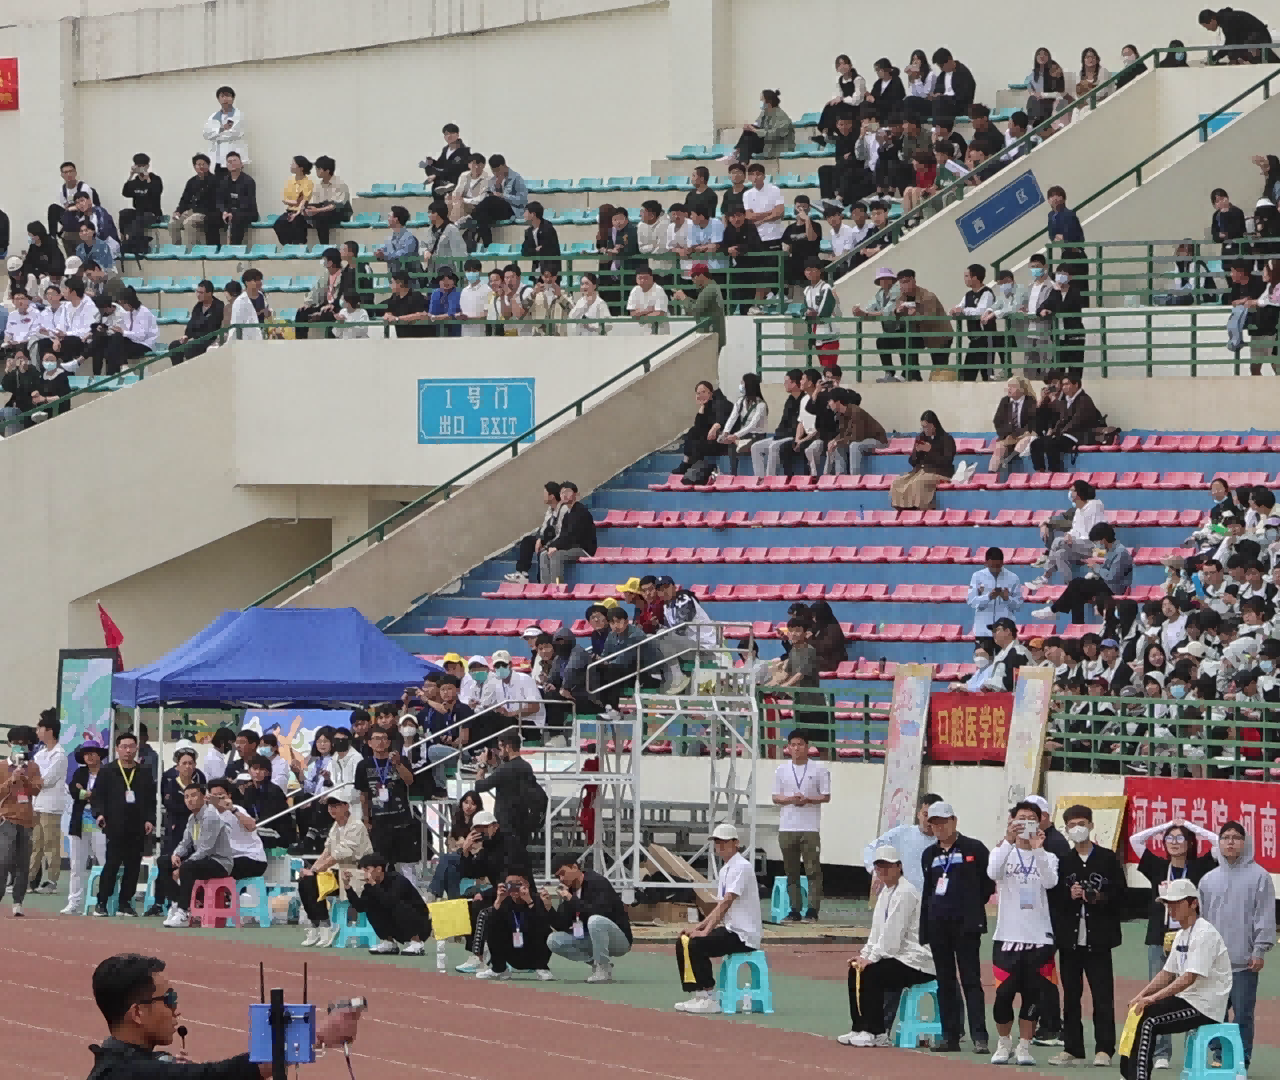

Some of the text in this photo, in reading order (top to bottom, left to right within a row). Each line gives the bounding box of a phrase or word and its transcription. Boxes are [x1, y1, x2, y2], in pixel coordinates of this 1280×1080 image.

[445, 385, 508, 410] 1号门
[439, 415, 518, 435] 出口 EXIT
[937, 704, 1006, 750] 口腔医学院
